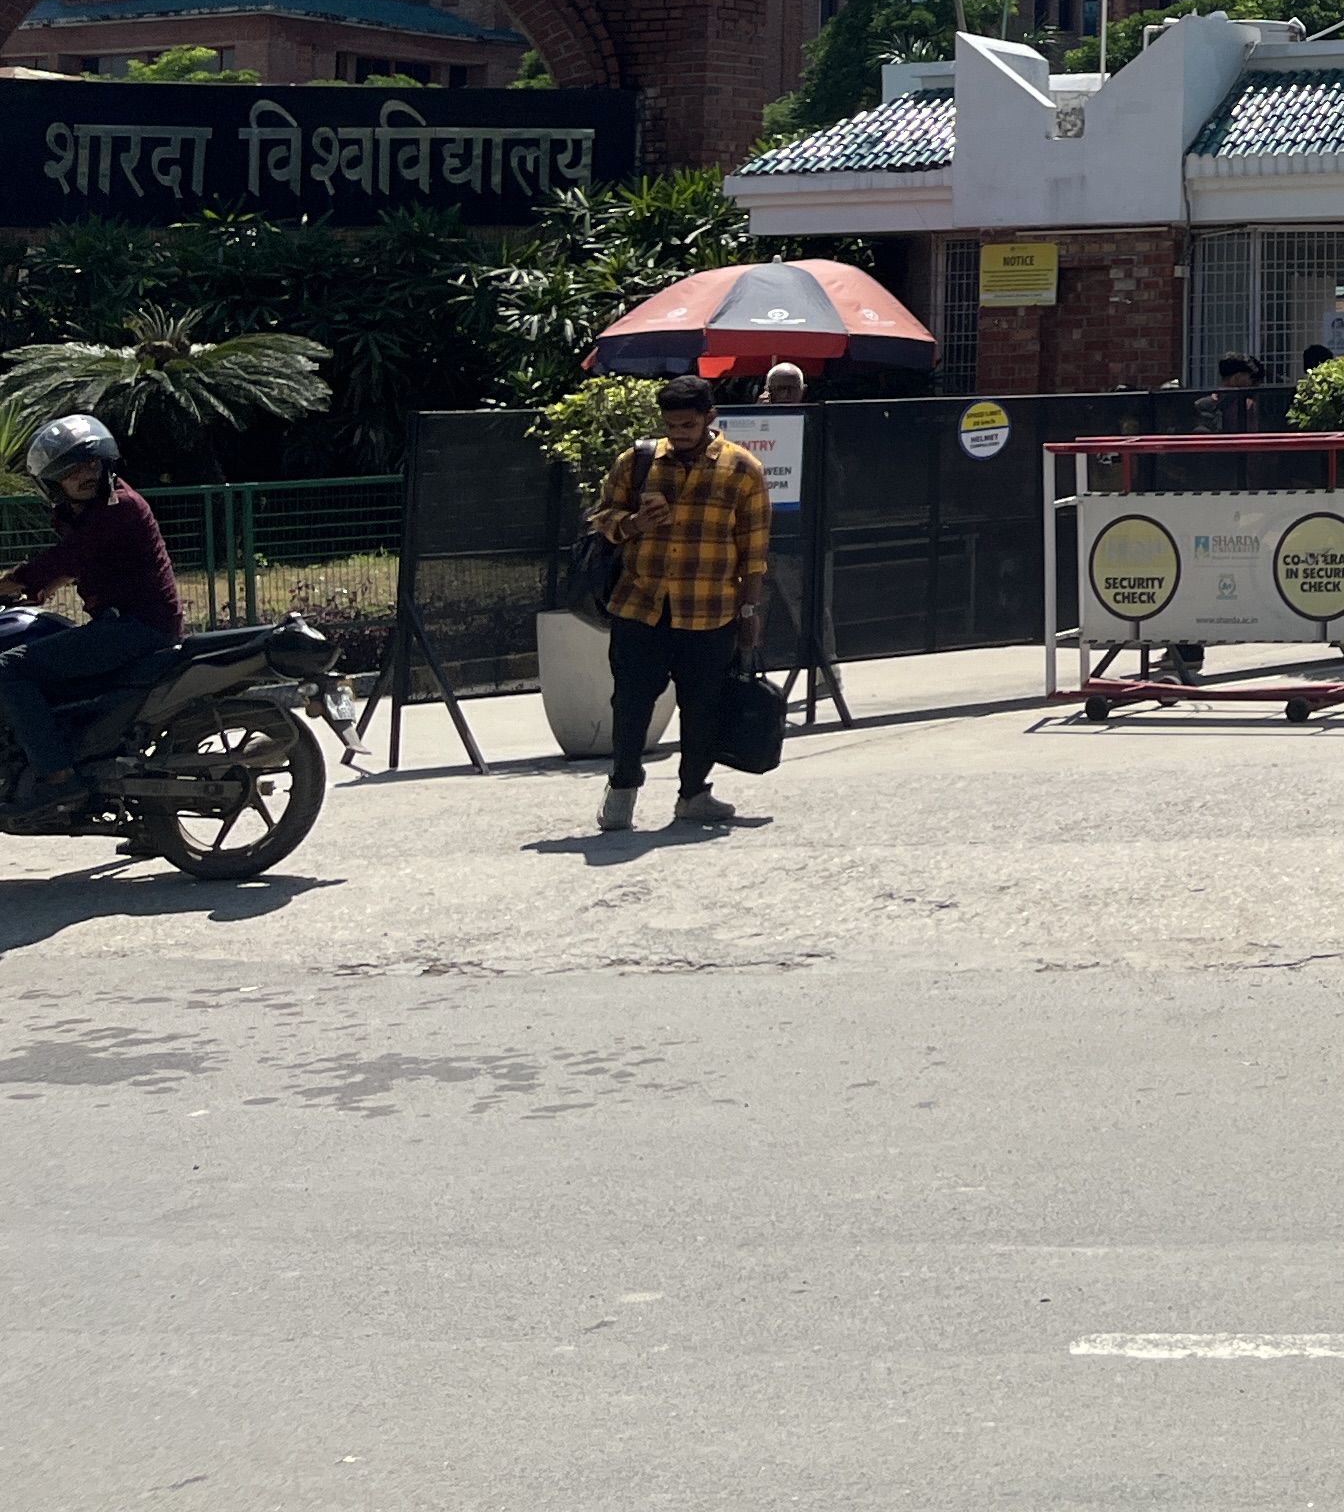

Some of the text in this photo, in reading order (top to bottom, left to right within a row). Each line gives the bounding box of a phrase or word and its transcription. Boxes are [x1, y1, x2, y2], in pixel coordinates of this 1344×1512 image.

[44, 99, 596, 198] शारदा विश्वविद्यालय
[1003, 255, 1035, 266] NOTICE
[1211, 535, 1260, 546] SHARDA
[1286, 568, 1299, 579] IN
[1104, 577, 1165, 590] SECURITY
[1300, 580, 1342, 593] CHECK
[1113, 591, 1156, 604] CHECK
